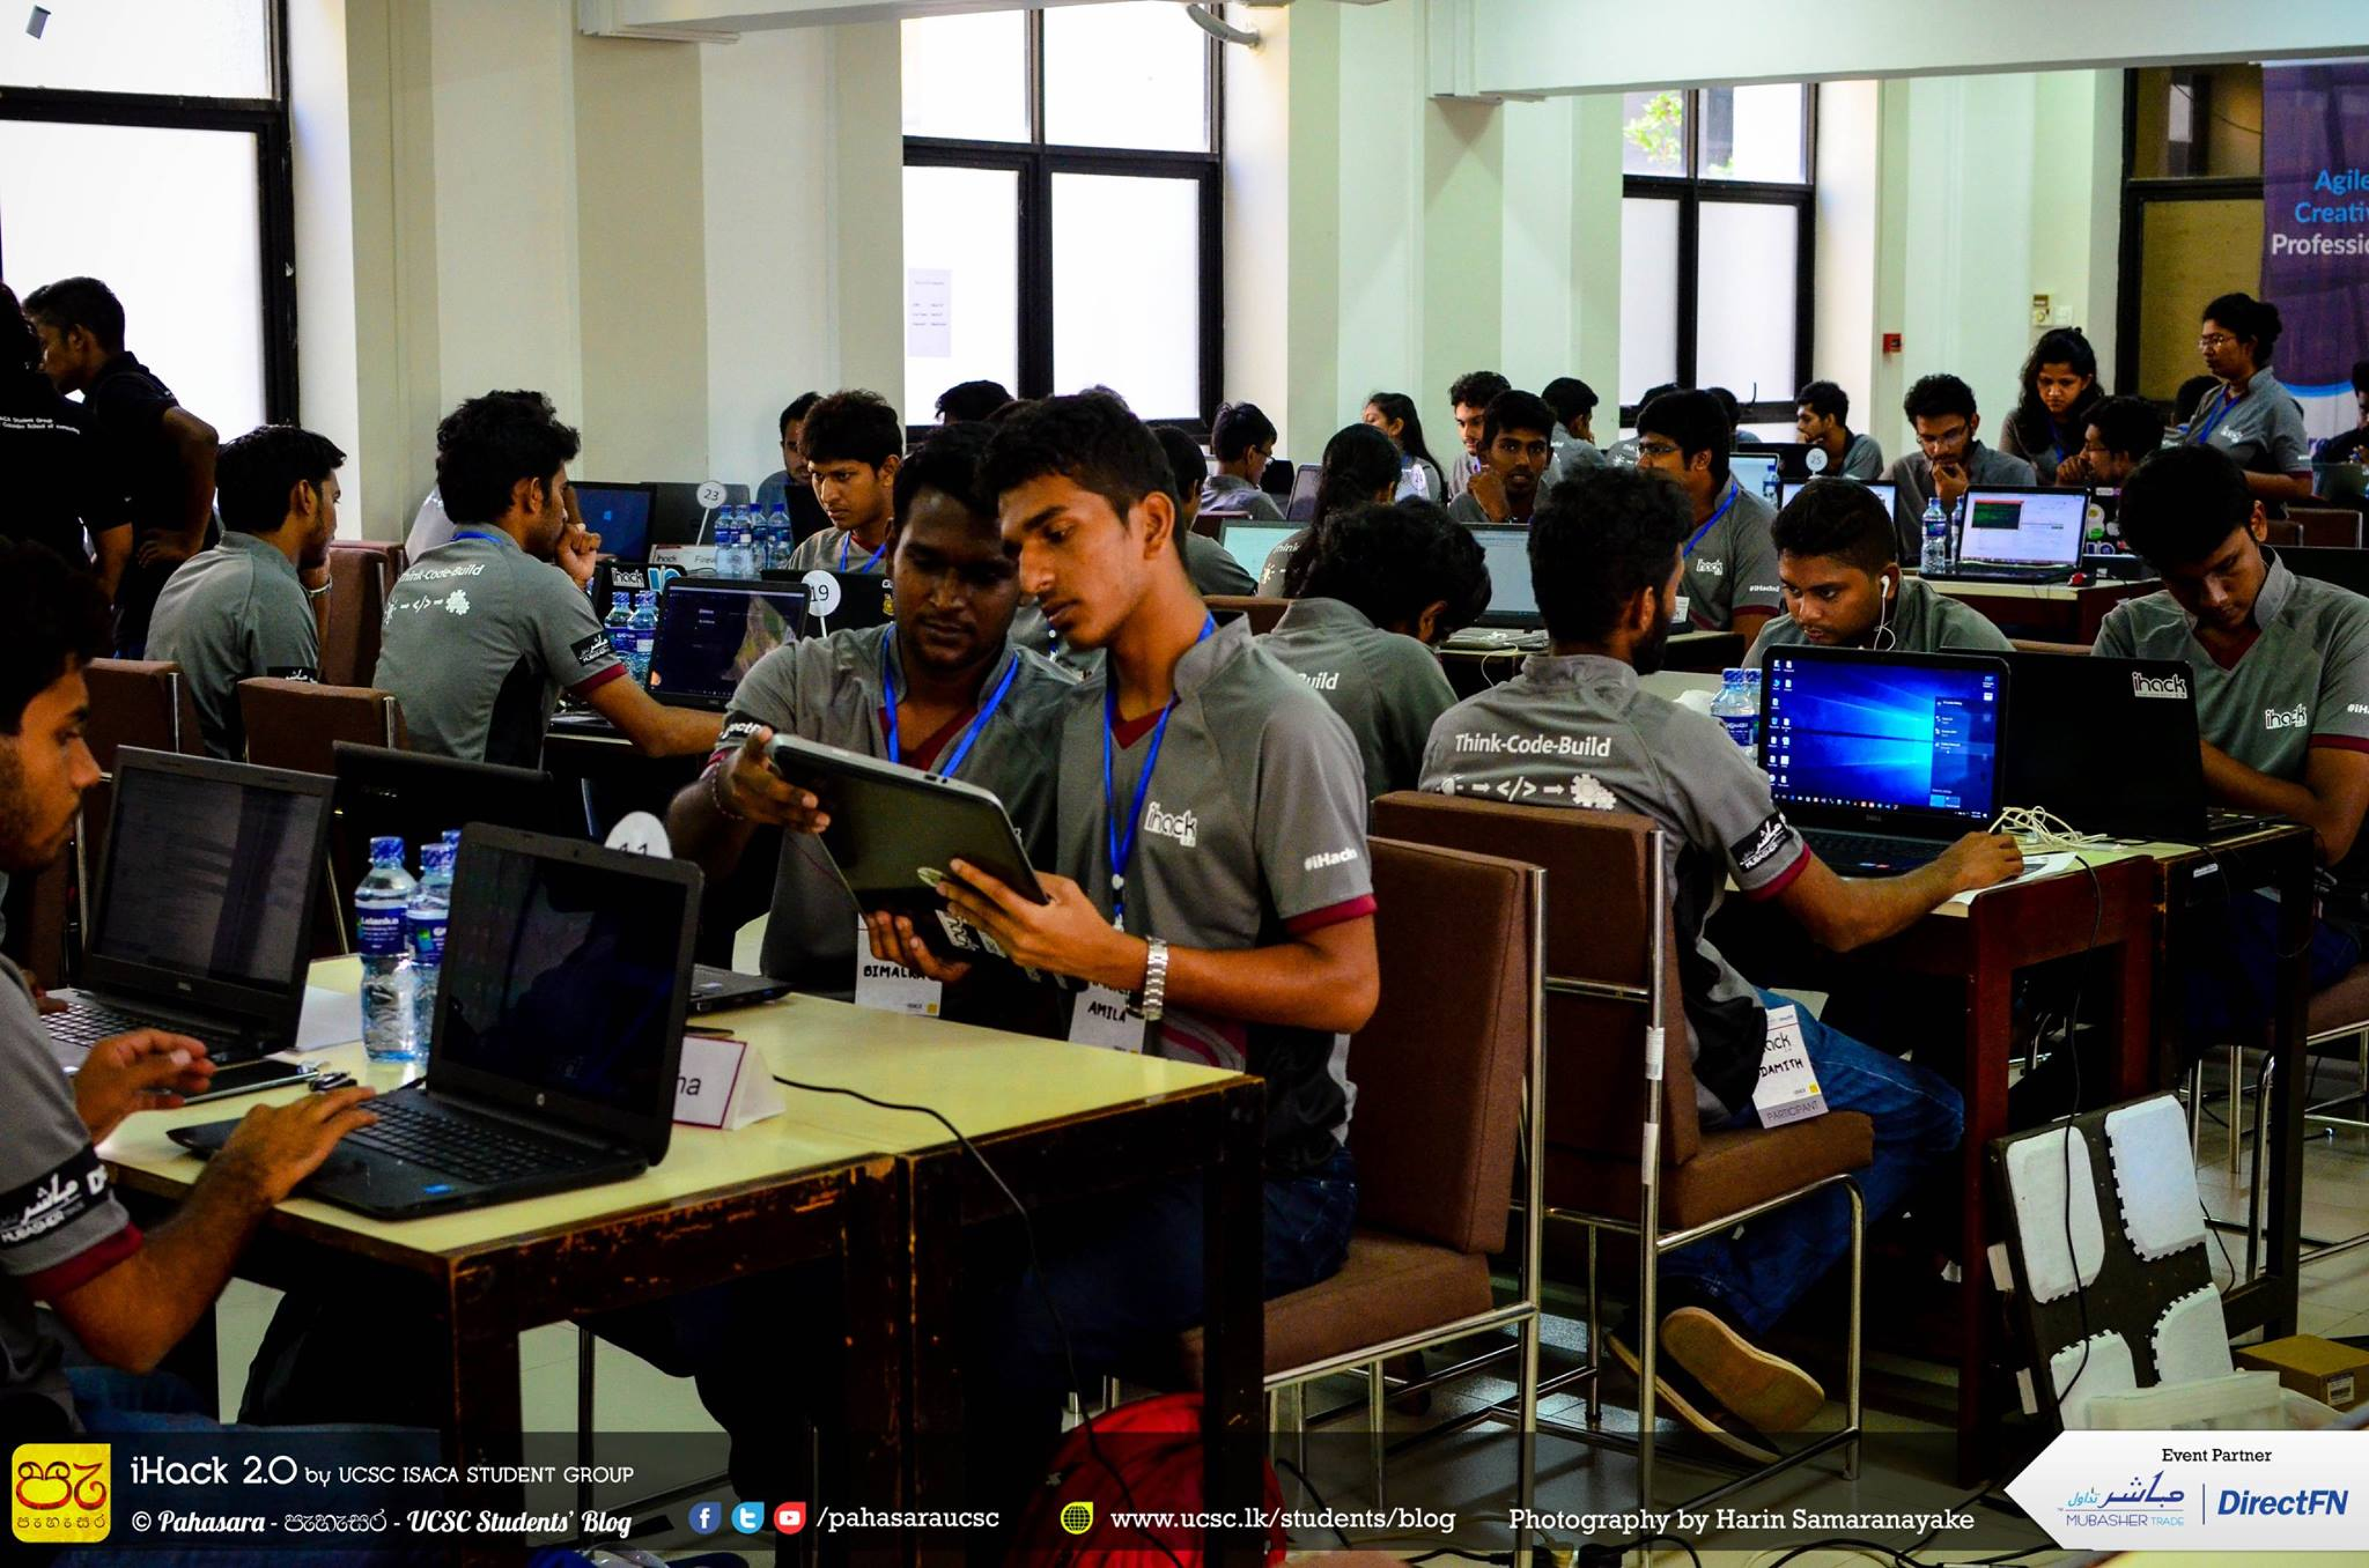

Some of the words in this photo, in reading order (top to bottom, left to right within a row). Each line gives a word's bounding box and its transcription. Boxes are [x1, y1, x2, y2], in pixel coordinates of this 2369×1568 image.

[704, 489, 720, 502] 23
[811, 584, 829, 603] 19
[2132, 672, 2187, 698] ihack
[1455, 733, 1611, 757] Think-Code-Build
[1088, 1001, 1127, 1023] AMILA
[1767, 1100, 1819, 1122] PARTICIPANT
